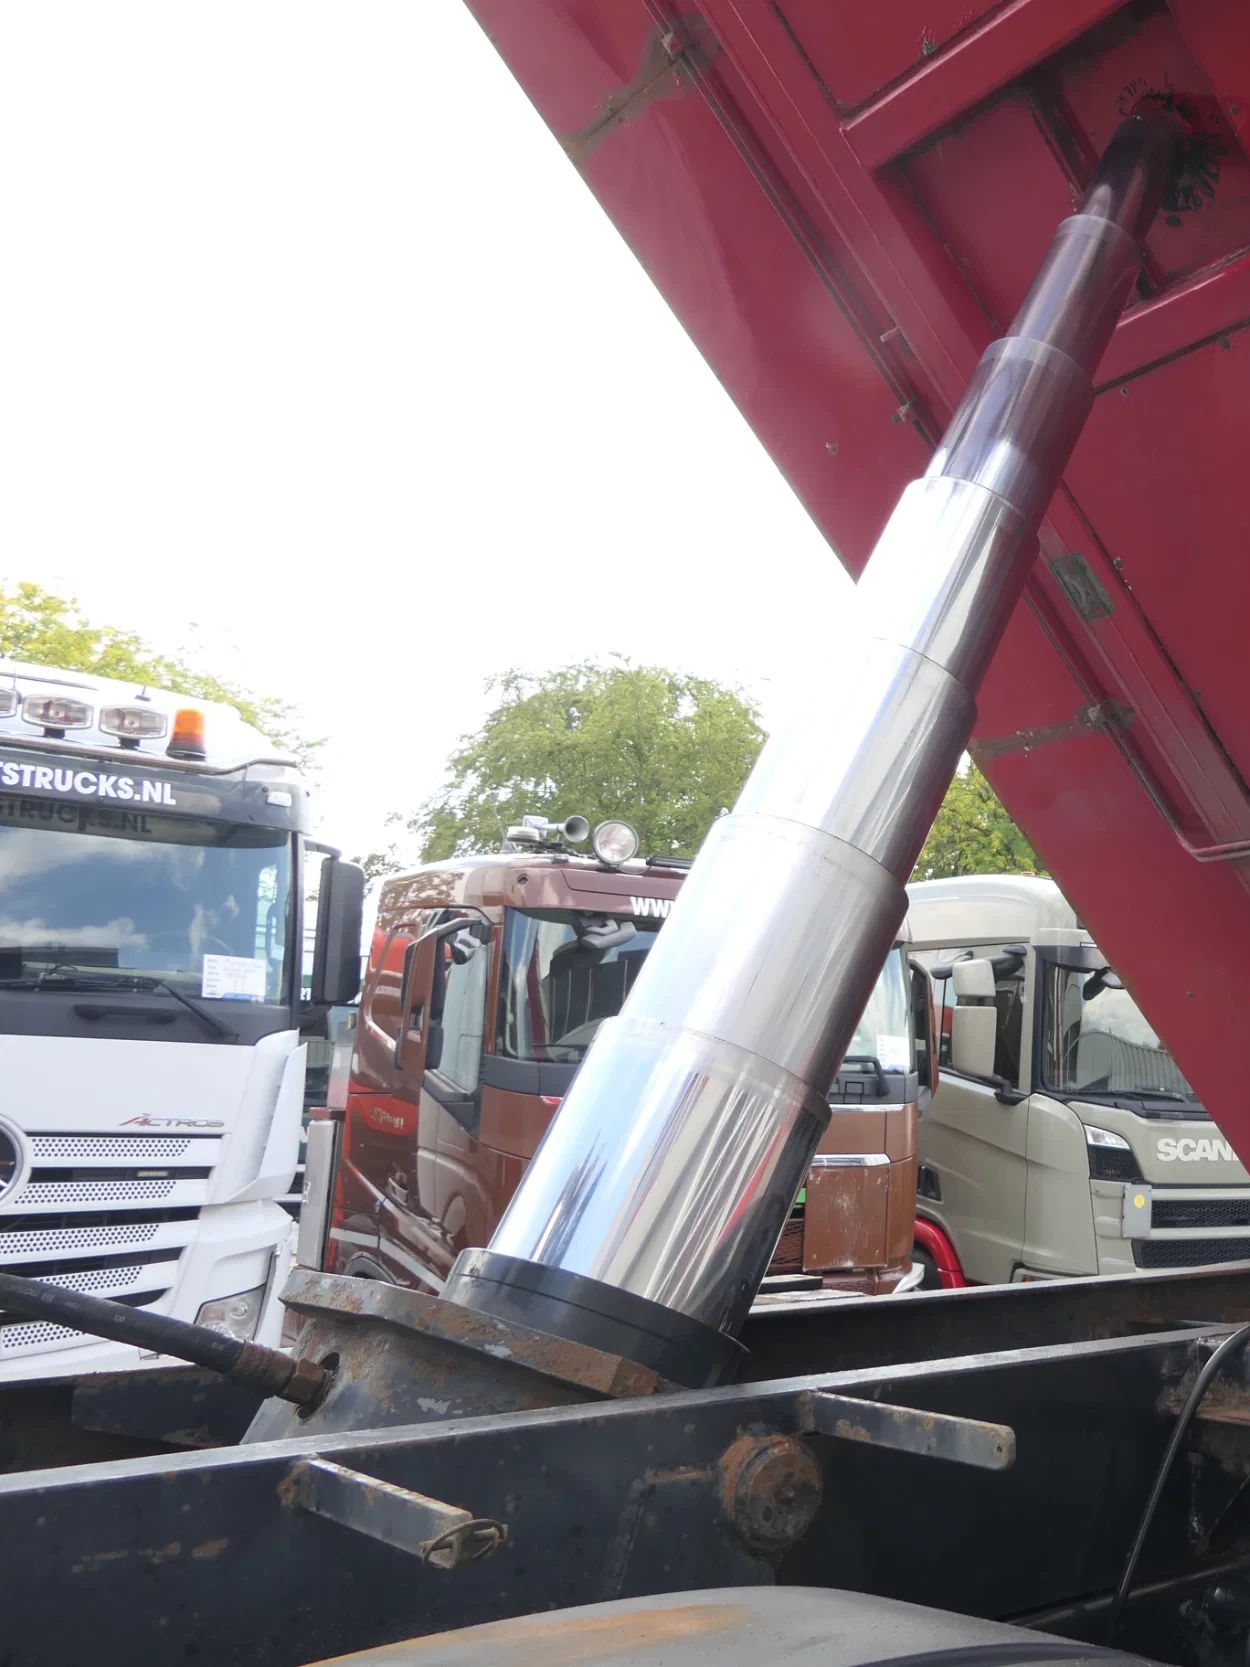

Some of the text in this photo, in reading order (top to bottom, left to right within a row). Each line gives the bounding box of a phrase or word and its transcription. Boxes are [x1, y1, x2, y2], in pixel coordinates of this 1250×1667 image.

[0, 761, 177, 806] STRUCKS.NL
[118, 1112, 225, 1128] ACTROS
[1156, 1138, 1241, 1162] SCAN
